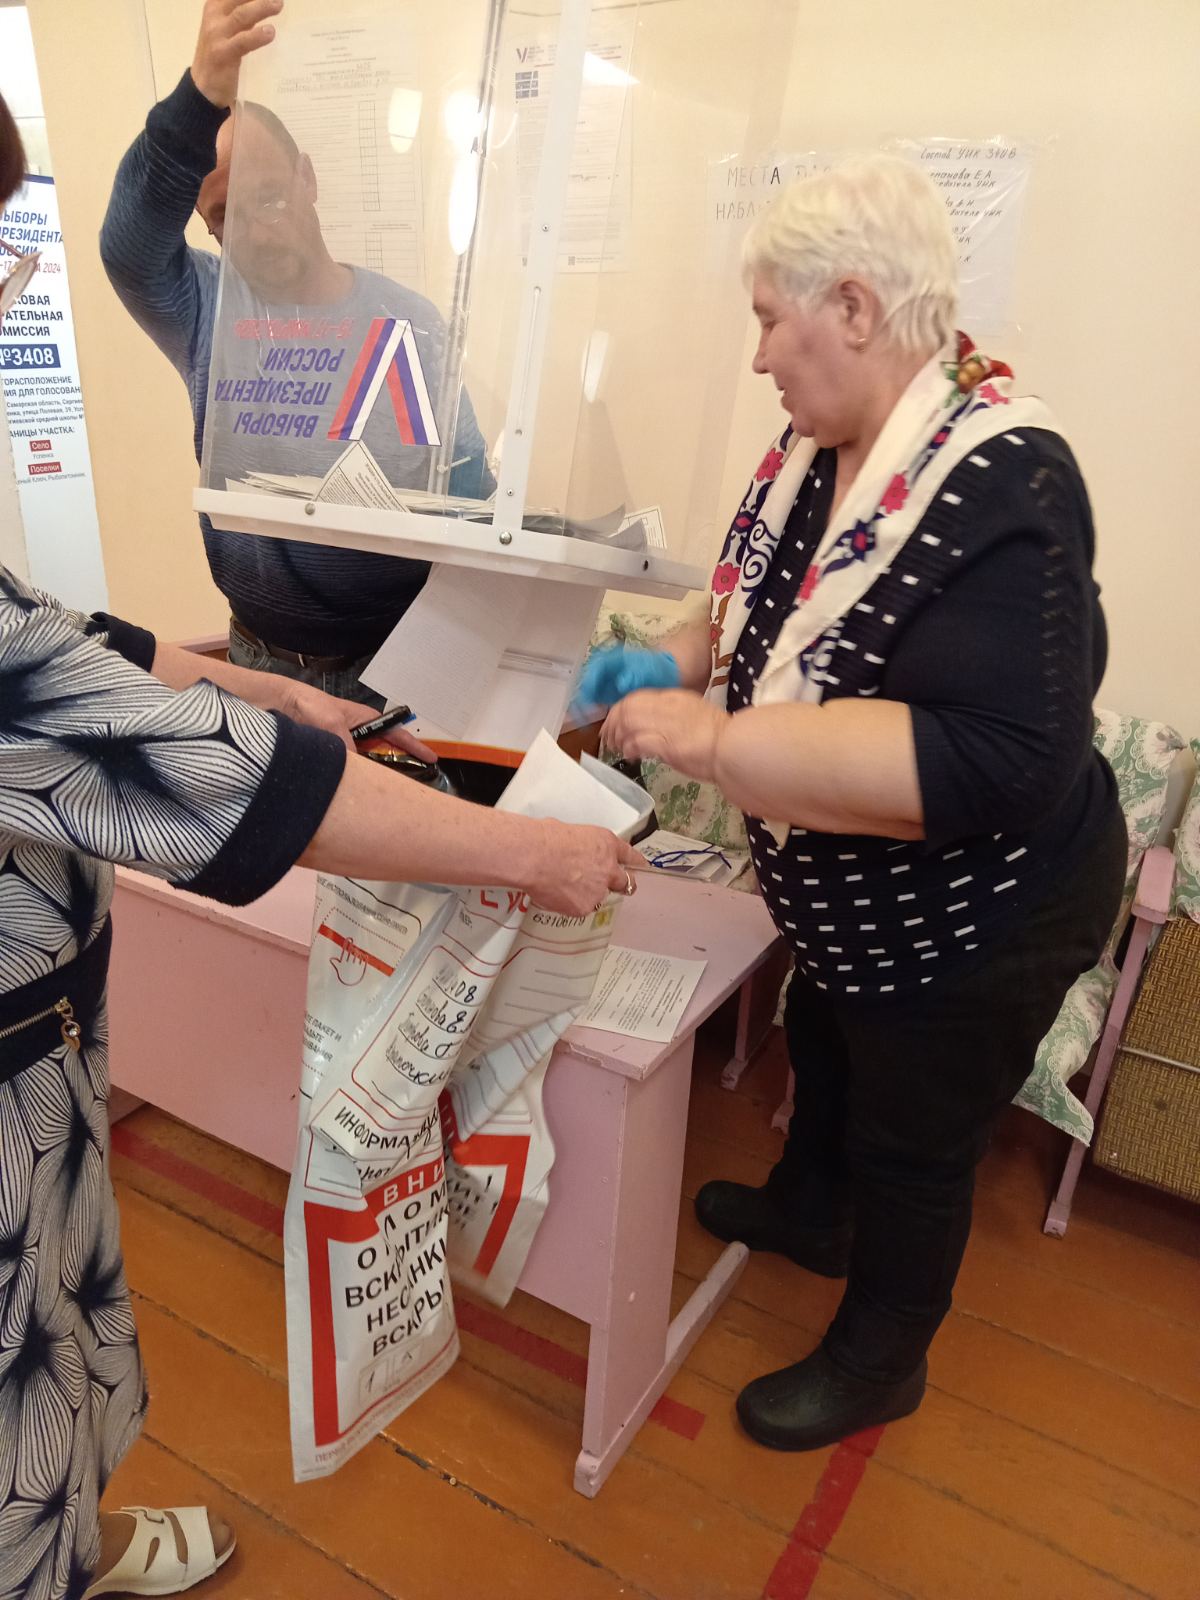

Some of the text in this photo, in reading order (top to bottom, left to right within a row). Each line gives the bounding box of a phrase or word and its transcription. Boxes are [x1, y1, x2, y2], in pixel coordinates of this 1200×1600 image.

[727, 166, 781, 187] МЕСТА
[2, 210, 48, 226] ЫБОРЫ
[716, 201, 756, 221] НАБЛ
[3, 311, 64, 321] АТЕЛЬНАЯ
[264, 347, 344, 372] РОССИИ
[4, 376, 73, 386] ОРАСПОЛОЖЕНИЕ
[36, 386, 81, 395] ГОЛОСОВАН
[214, 379, 332, 405] ПРЕЗИДЕНТА
[233, 412, 319, 437] ВЫБОРЫ
[31, 442, 50, 450] Село
[384, 1155, 446, 1208] ВНИ
[372, 1279, 445, 1358] ВСКРЫ
